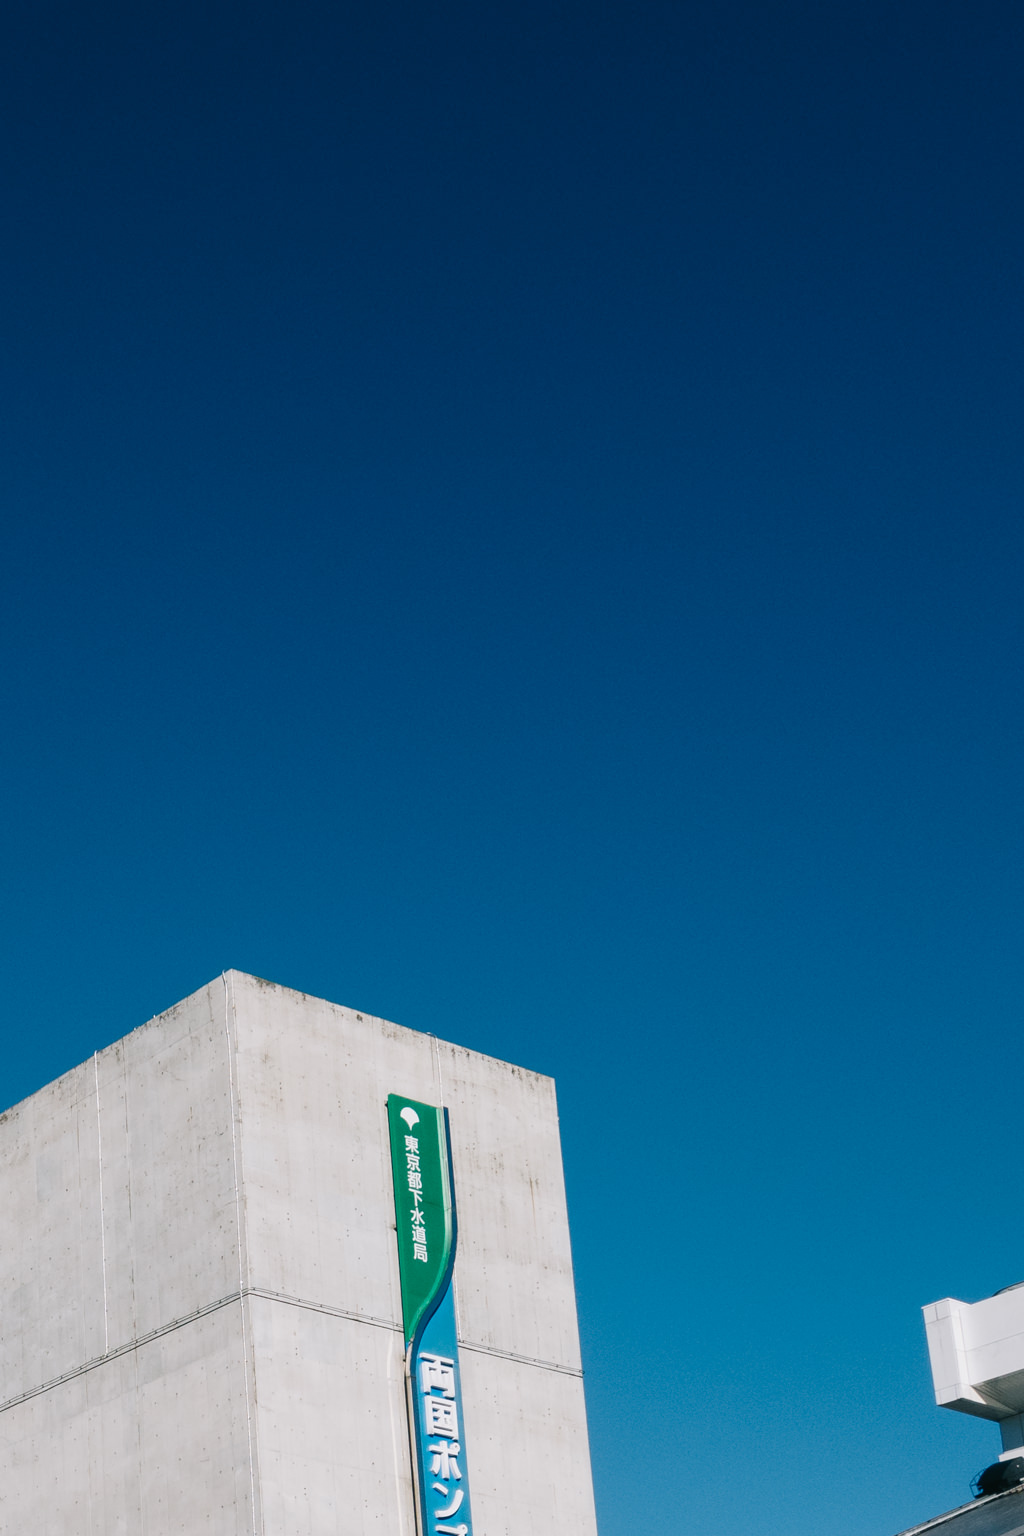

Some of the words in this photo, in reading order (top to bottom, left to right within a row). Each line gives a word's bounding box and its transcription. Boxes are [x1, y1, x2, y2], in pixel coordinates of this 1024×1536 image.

[404, 1135, 428, 1263] 東京都下水道局
